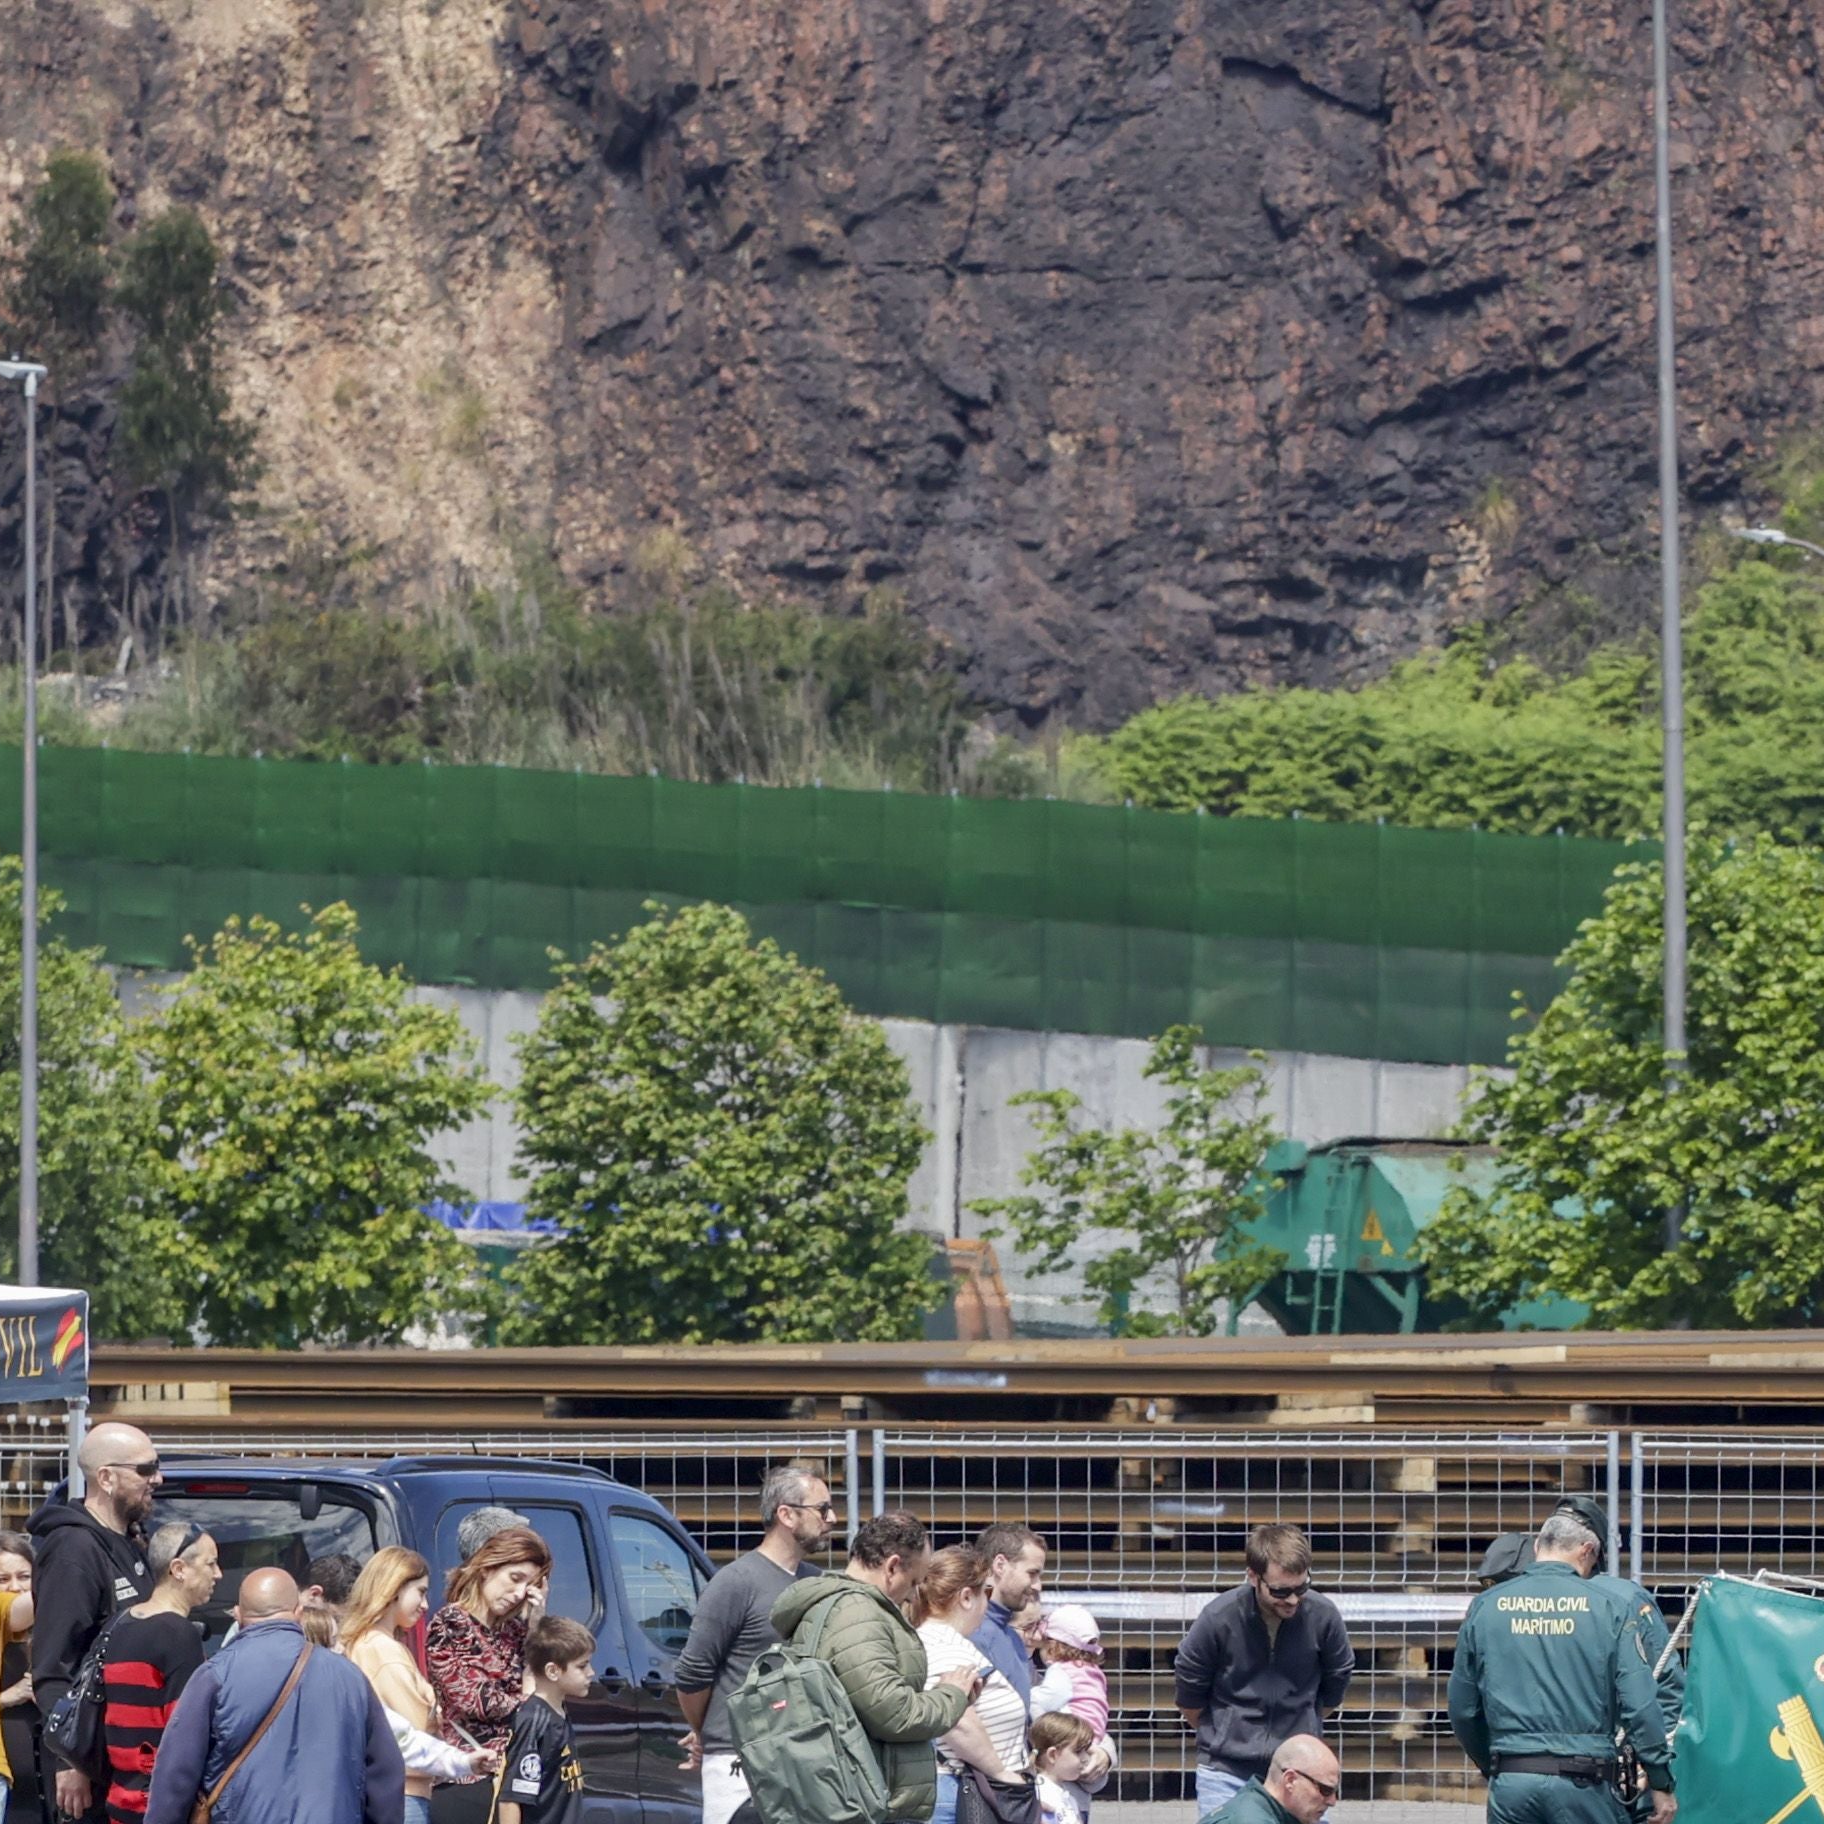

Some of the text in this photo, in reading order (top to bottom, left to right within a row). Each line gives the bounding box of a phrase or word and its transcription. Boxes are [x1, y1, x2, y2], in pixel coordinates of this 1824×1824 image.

[1496, 1596, 1591, 1613] GUARDIA CIVIL
[1511, 1616, 1575, 1636] MARÍTIMO
